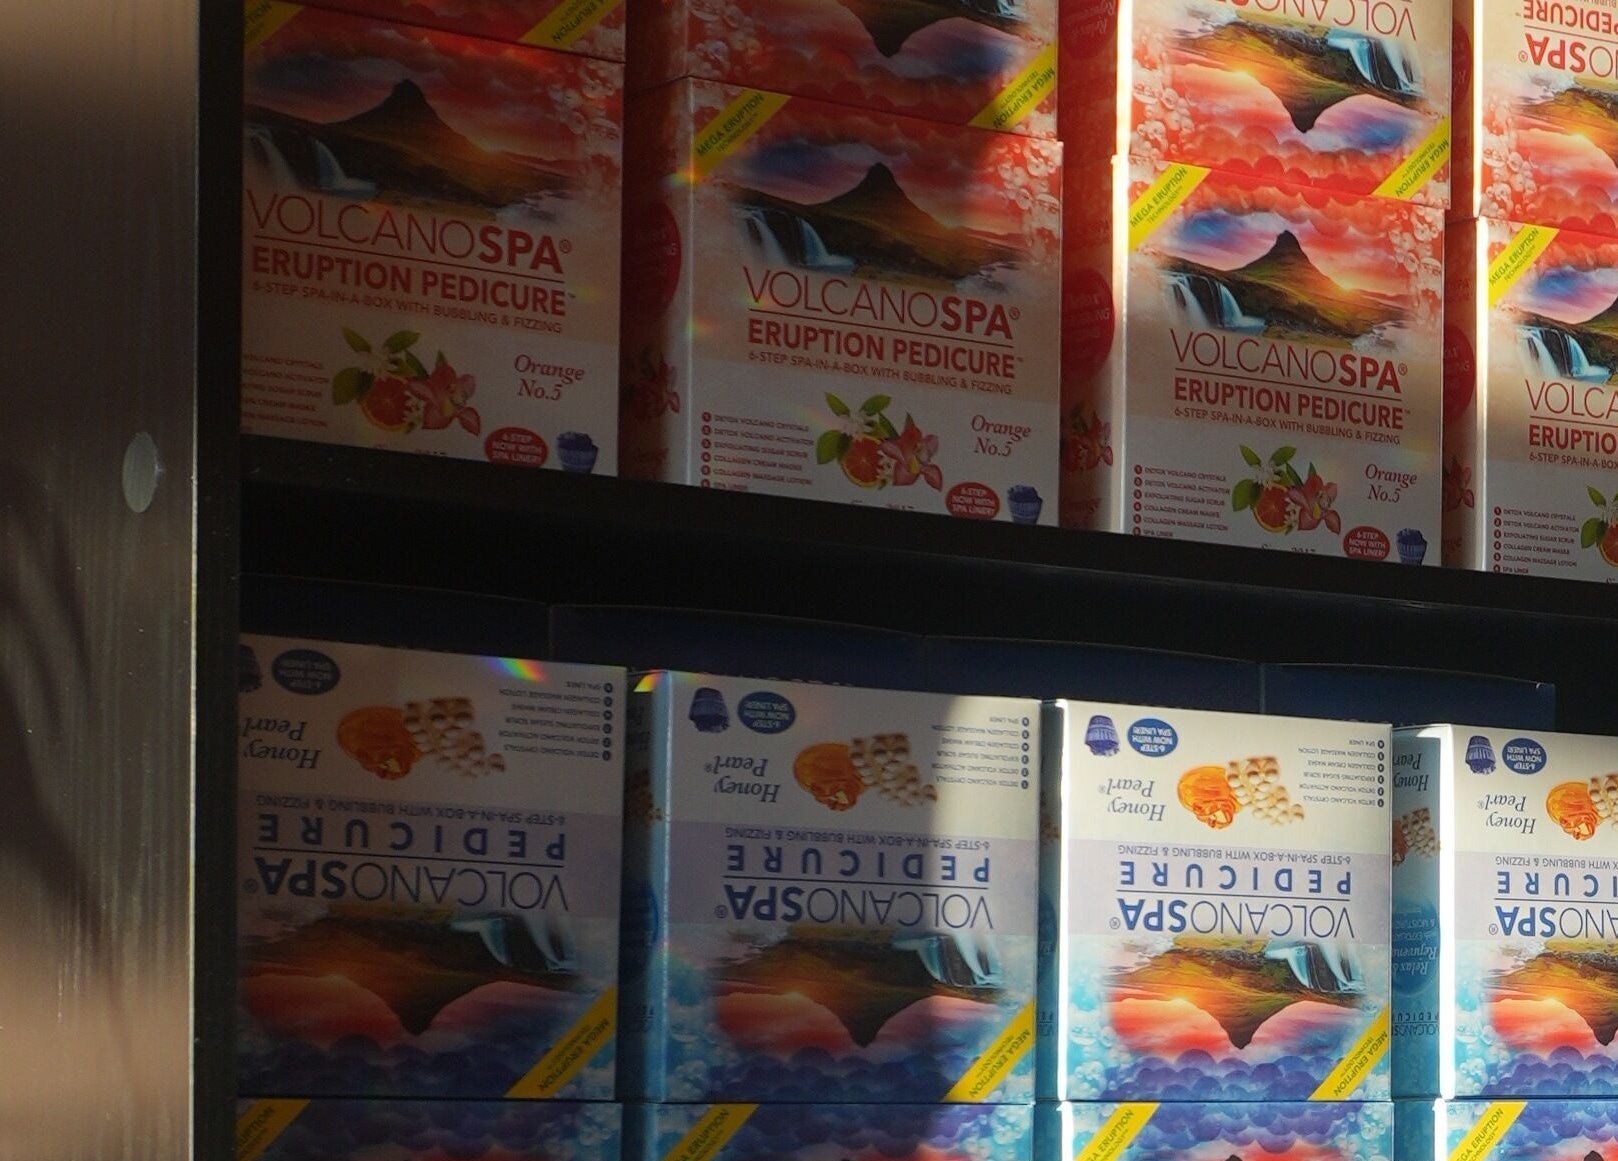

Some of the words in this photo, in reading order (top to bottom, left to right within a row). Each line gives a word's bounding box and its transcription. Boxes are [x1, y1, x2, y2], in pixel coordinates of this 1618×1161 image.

[252, 246, 411, 294] ERUPTION
[748, 318, 884, 361] ERUPTION
[514, 354, 585, 385] Orange
[518, 379, 563, 400] No.5
[1175, 377, 1290, 414] ERUPTION
[972, 414, 1031, 439] Orange
[1175, 407, 1208, 419] 6-STEP
[1211, 411, 1276, 428] SPA-IN-A-BOX
[1279, 420, 1303, 431] WITH
[1306, 423, 1352, 438] BUBBLING
[1365, 432, 1400, 444] FIZZING
[974, 437, 1012, 457] No.5
[1365, 464, 1417, 488] Orange
[1368, 484, 1400, 503] No.5
[242, 739, 320, 769] Honey
[714, 775, 780, 802] Honey
[1108, 802, 1166, 821] Honey
[1486, 811, 1535, 834] Honey
[258, 814, 566, 861] PEDICURE
[726, 845, 989, 882] PEDICURE
[1120, 861, 1351, 895] PEDICURE
[1471, 1108, 1503, 1148] ERUPTION
